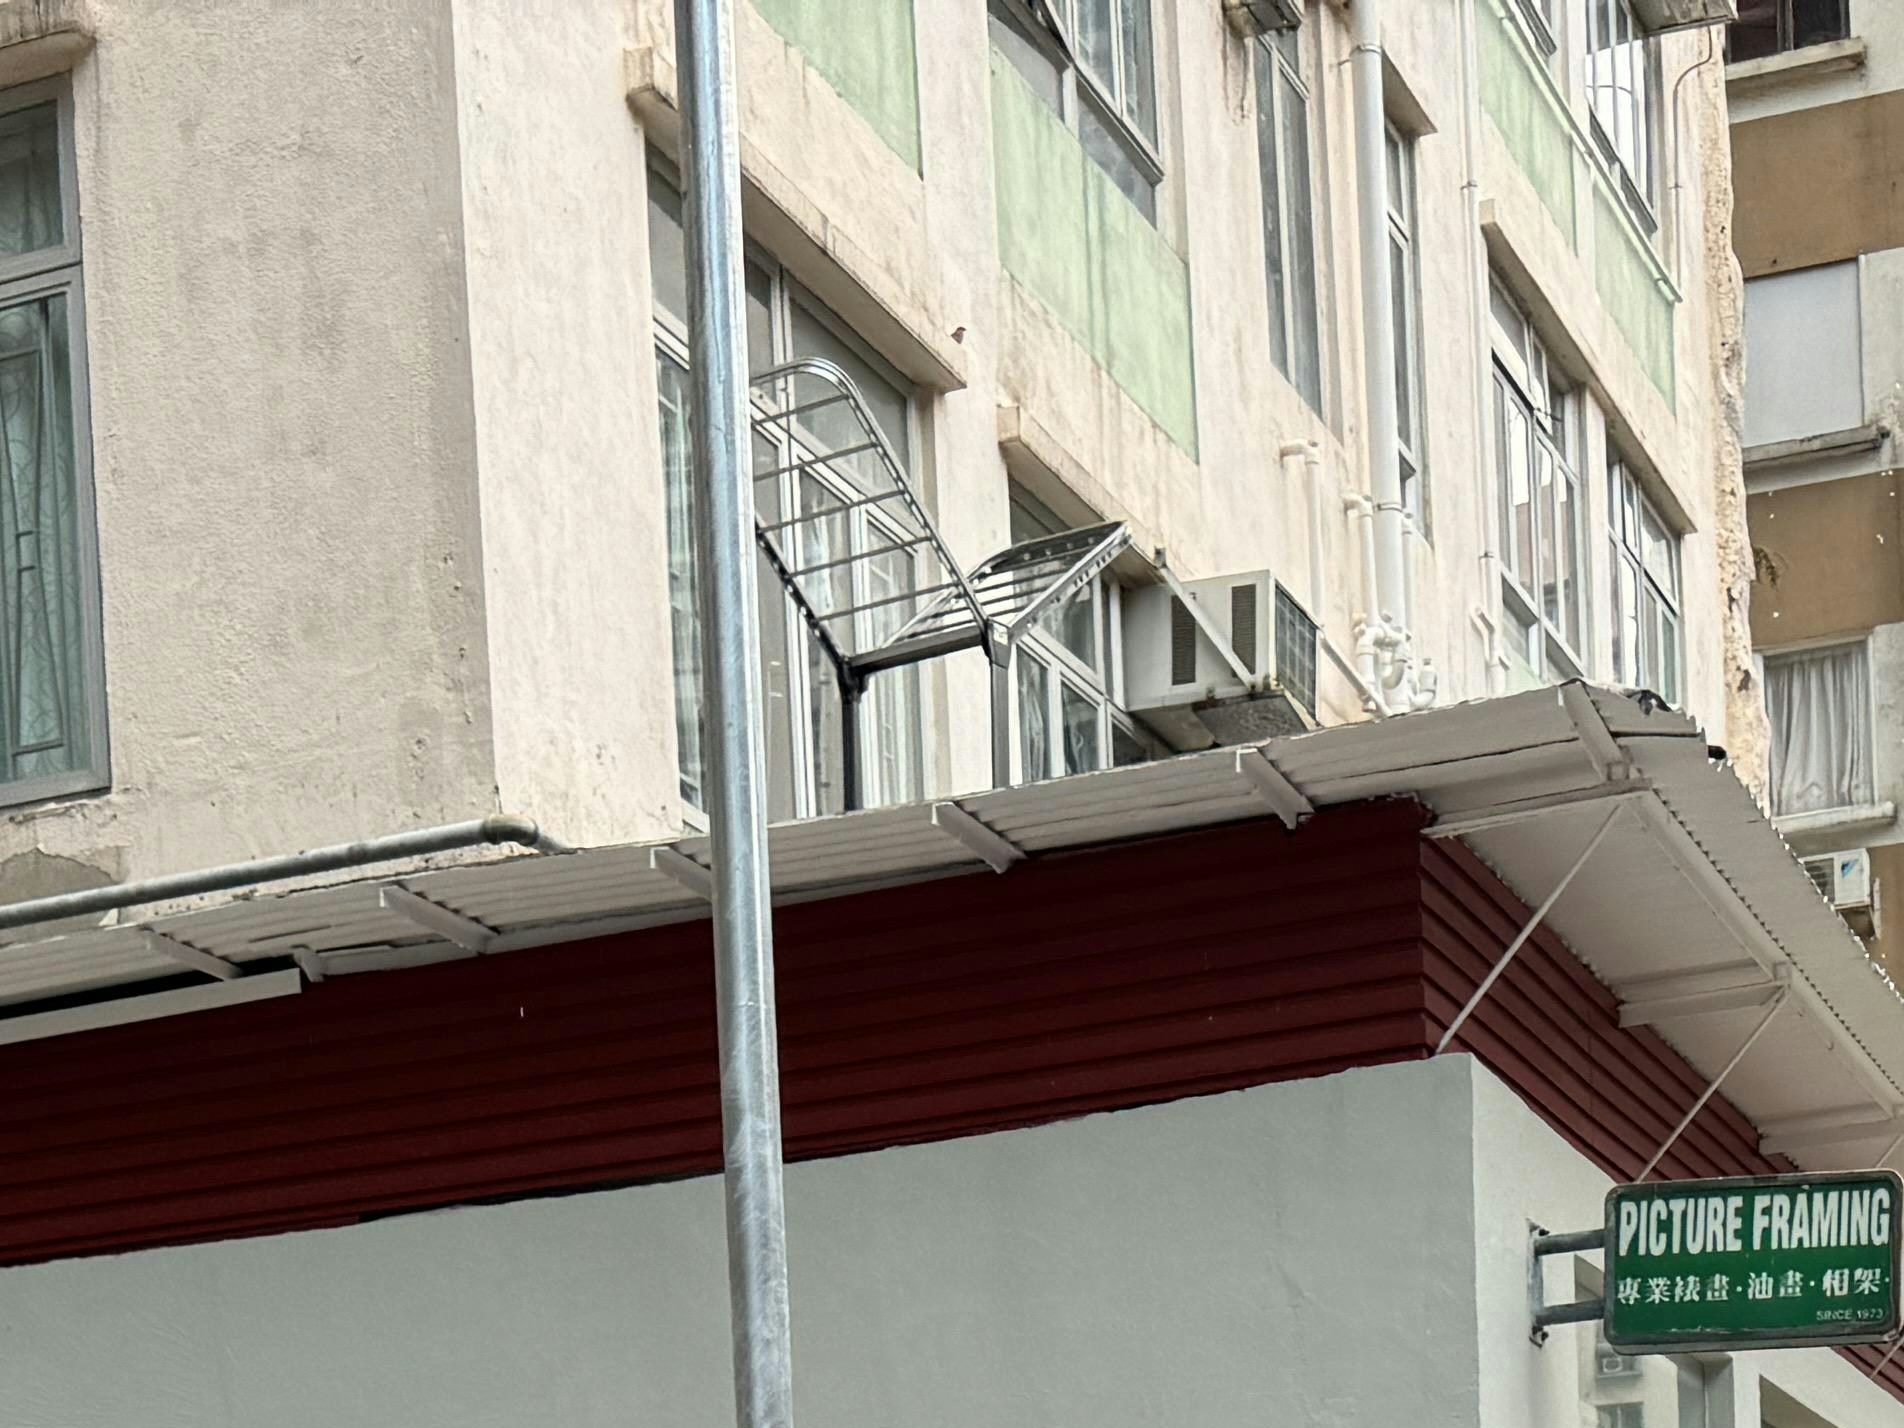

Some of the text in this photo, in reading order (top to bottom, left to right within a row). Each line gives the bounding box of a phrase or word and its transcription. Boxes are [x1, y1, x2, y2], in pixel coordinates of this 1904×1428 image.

[1618, 1187, 1891, 1257] PICTURE FRAMING
[1815, 1309, 1853, 1322] SINCE
